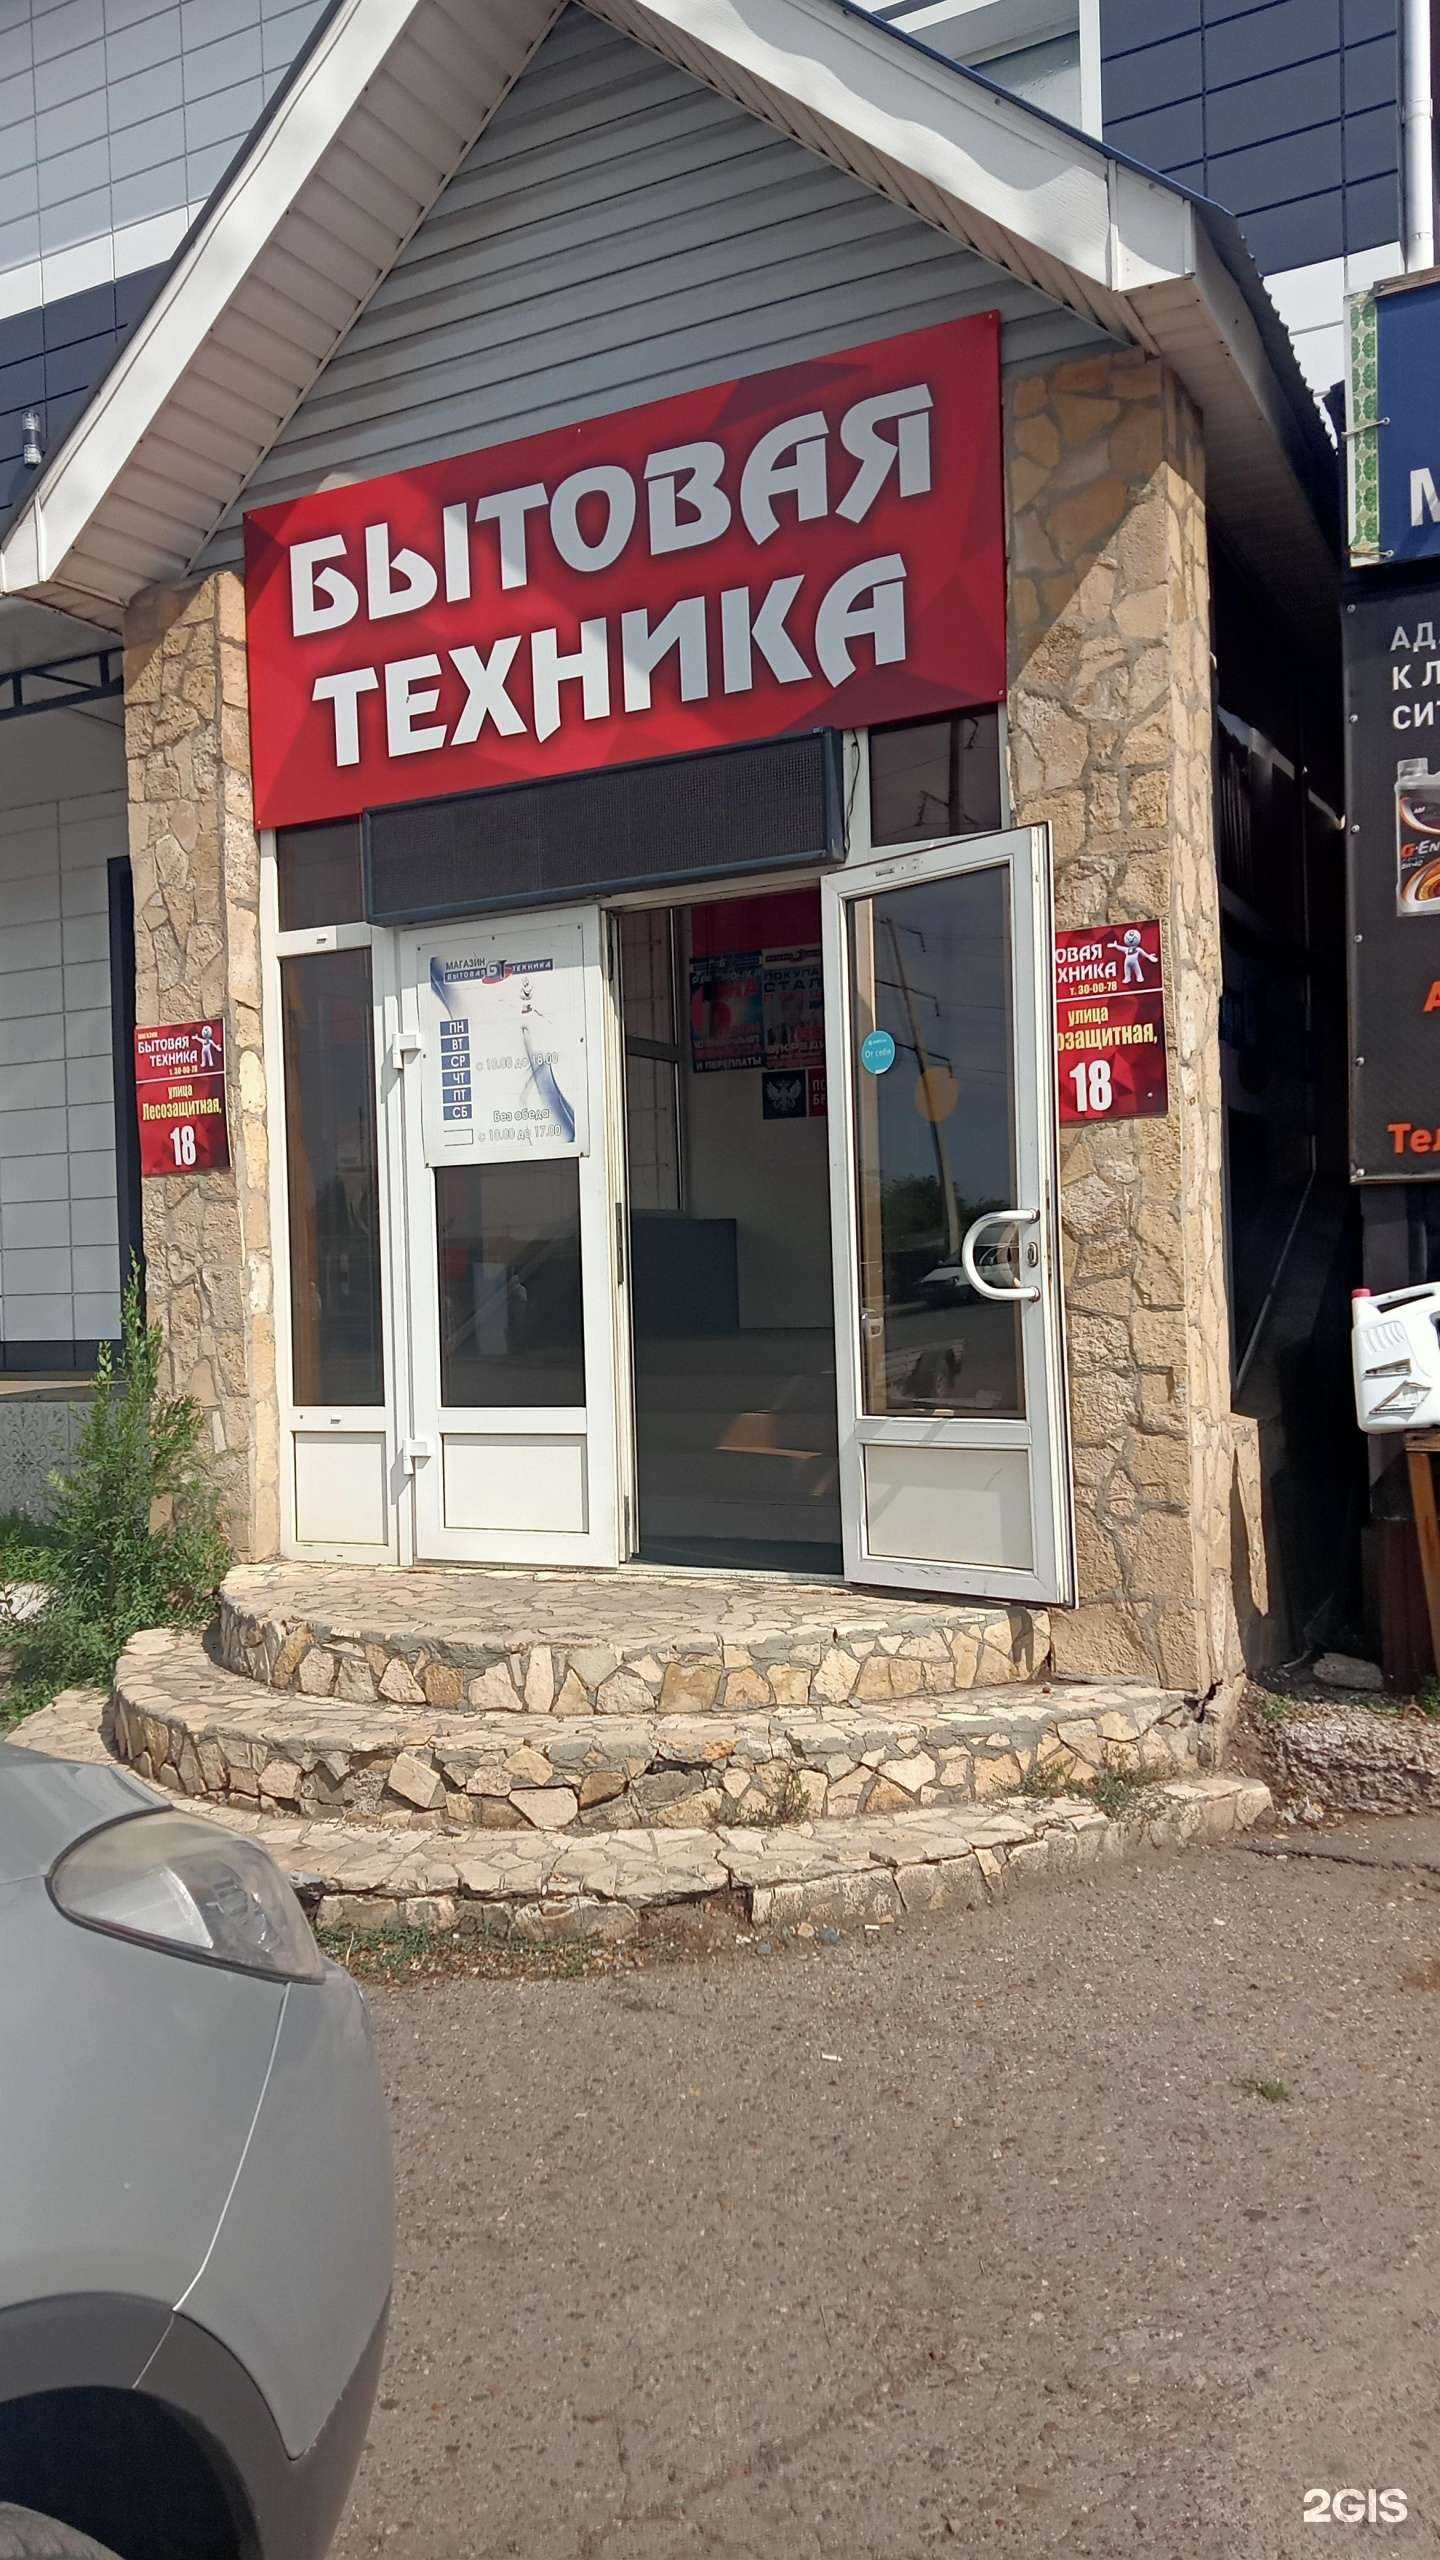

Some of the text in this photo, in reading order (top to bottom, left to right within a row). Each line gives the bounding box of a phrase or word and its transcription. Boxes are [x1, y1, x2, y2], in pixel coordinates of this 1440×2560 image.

[289, 383, 934, 637] БЫТОВАЯ
[1390, 621, 1440, 652] АД
[312, 553, 908, 767] ТЕХНИКА
[1392, 664, 1412, 690] К
[1392, 701, 1440, 730] СИ
[446, 958, 486, 971] МАГАЗИН
[1078, 981, 1118, 995] 30-00-78
[1068, 1006, 1109, 1027] улица
[449, 1022, 464, 1034] ПН
[137, 1035, 190, 1054] БЫТОВАЯ
[452, 1039, 463, 1050] ВТ
[149, 1050, 198, 1068] ТЕХНИКА
[450, 1056, 466, 1068] СР
[453, 1072, 466, 1084] ЧТ
[1069, 1059, 1113, 1112] 18
[167, 1084, 193, 1099] улица
[453, 1089, 466, 1101] ПТ
[142, 1098, 222, 1121] Лесозащитная,
[452, 1106, 468, 1118] СБ
[493, 1107, 550, 1123] Без обеда
[170, 1125, 197, 1166] 18
[1387, 1124, 1440, 1153] Те
